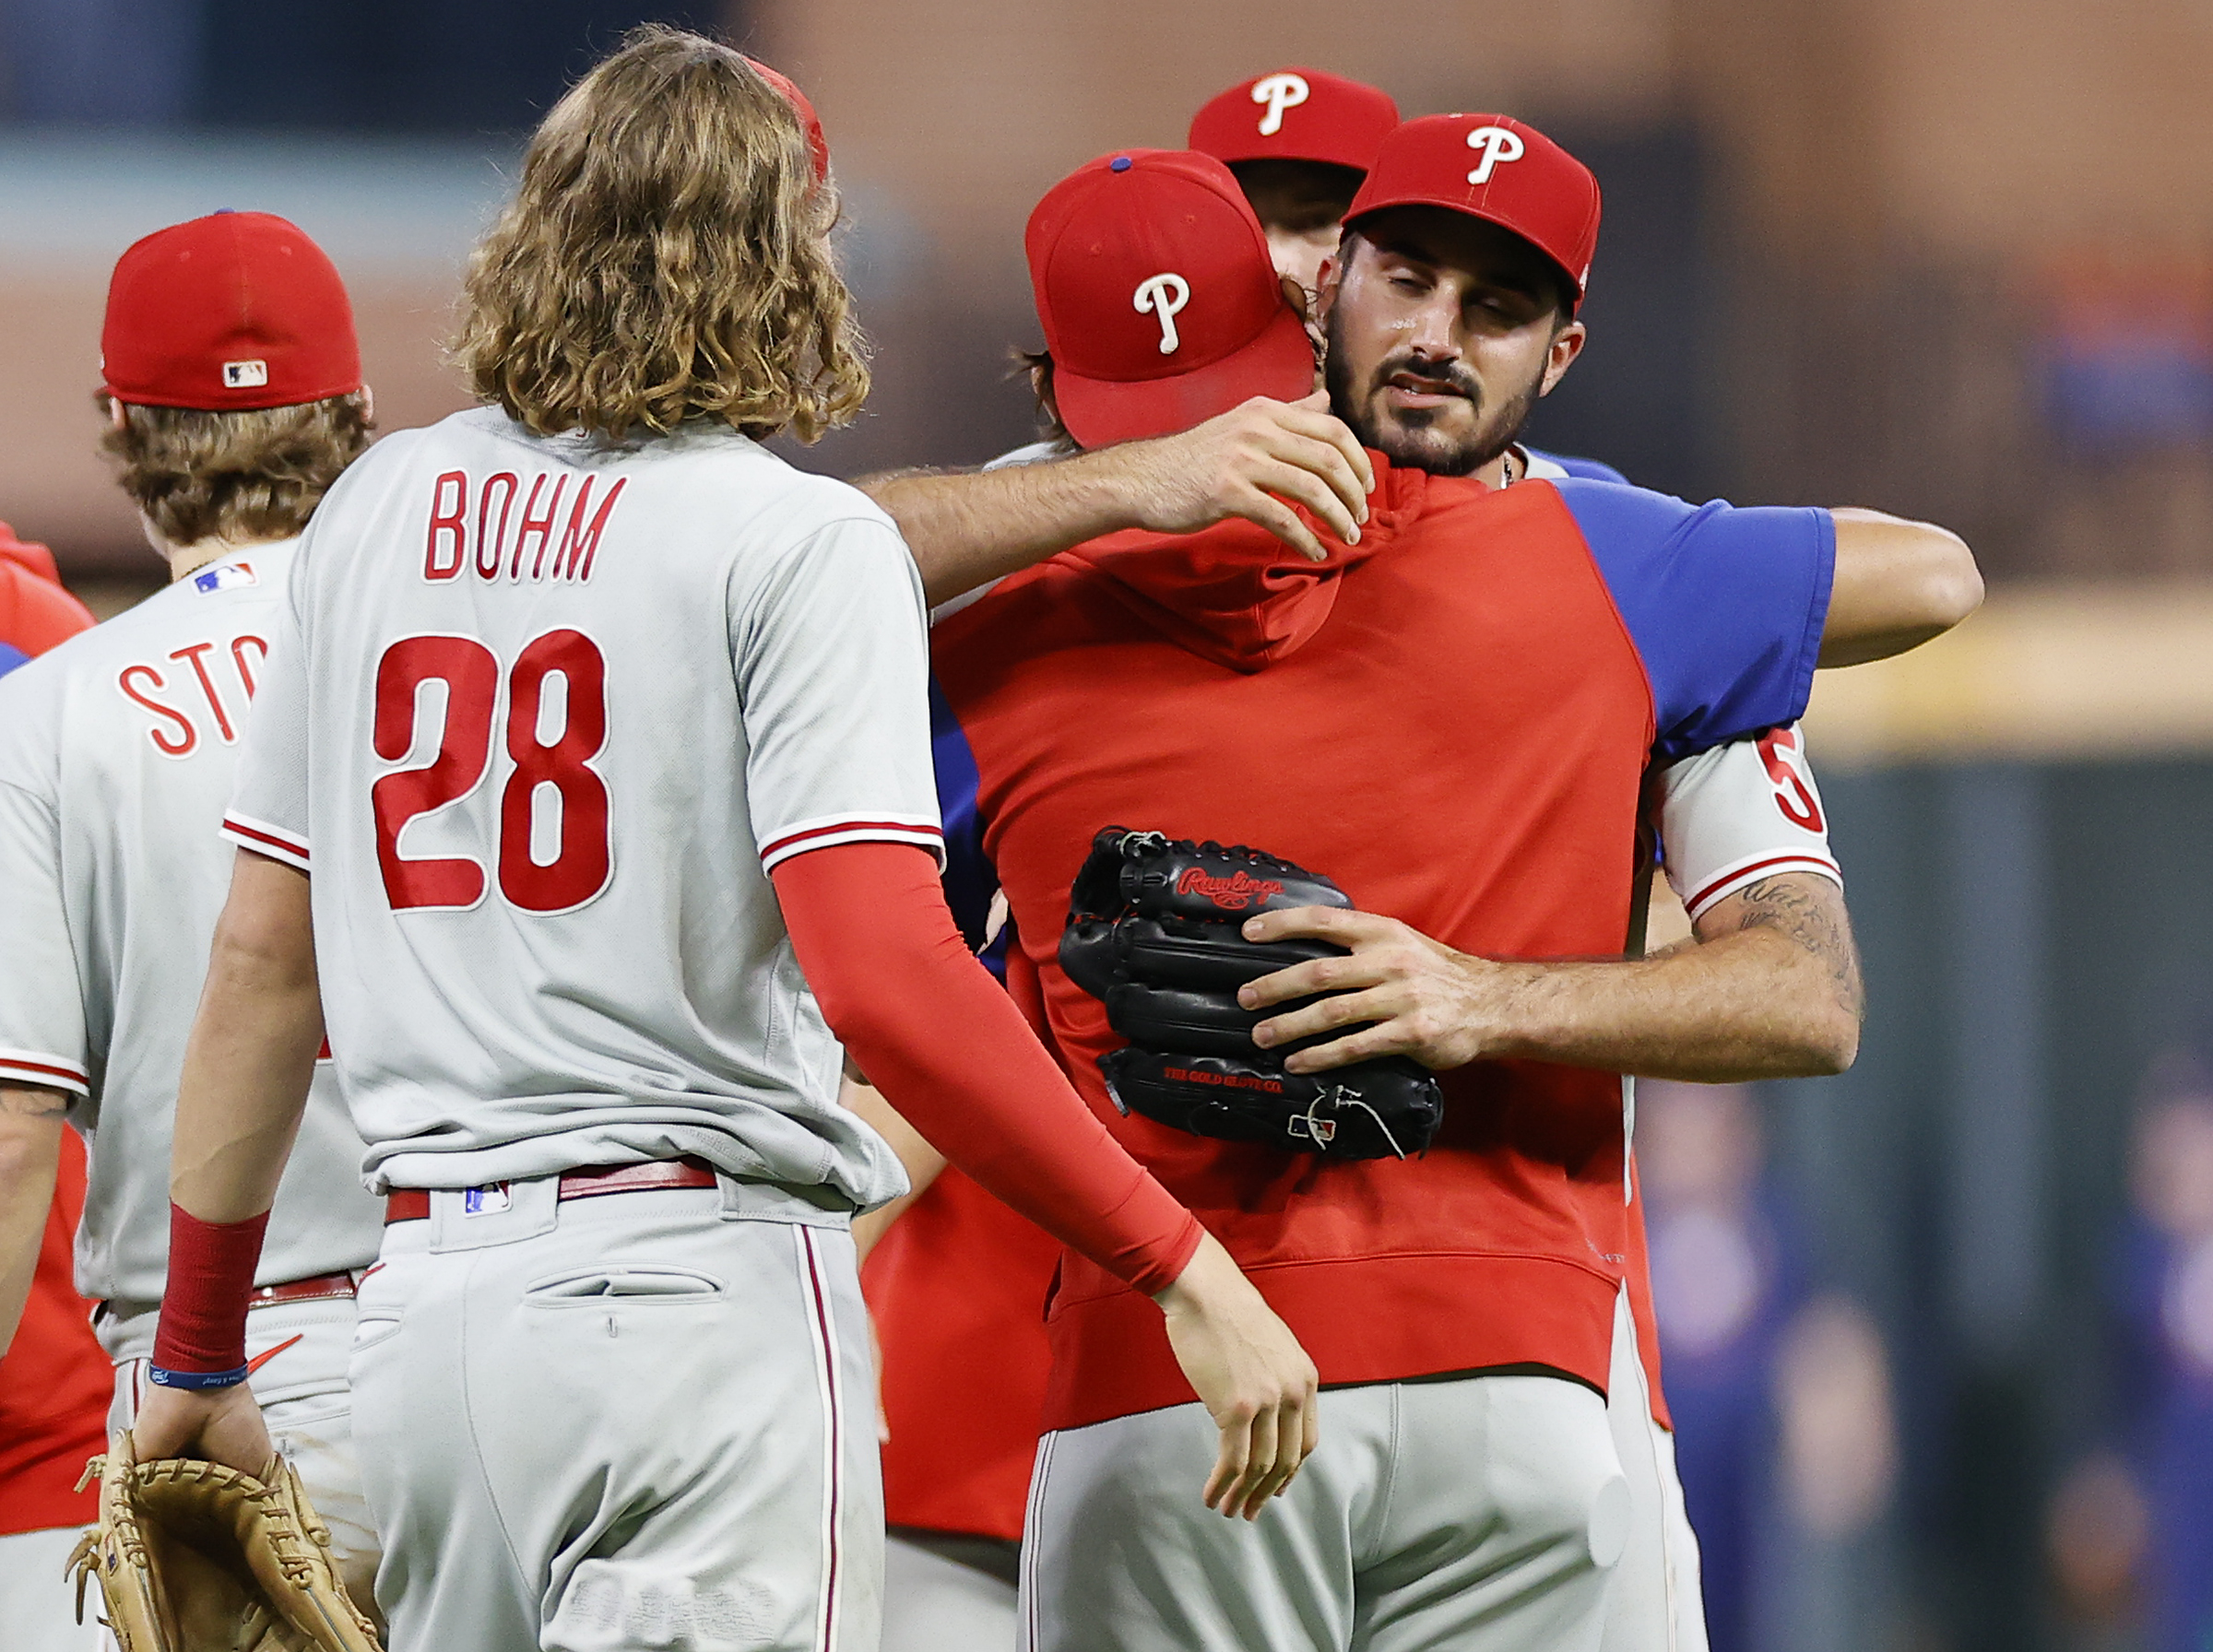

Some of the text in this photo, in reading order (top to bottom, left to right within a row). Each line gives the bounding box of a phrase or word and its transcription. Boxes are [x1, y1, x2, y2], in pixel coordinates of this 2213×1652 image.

[1251, 73, 1309, 136] P
[1466, 125, 1524, 185] P
[1133, 273, 1190, 356] P
[424, 468, 629, 582] BOHM
[372, 627, 610, 912] 28
[1177, 866, 1286, 905] Rawlings
[1164, 1066, 1189, 1081] THE
[1189, 1070, 1223, 1085] GOLD
